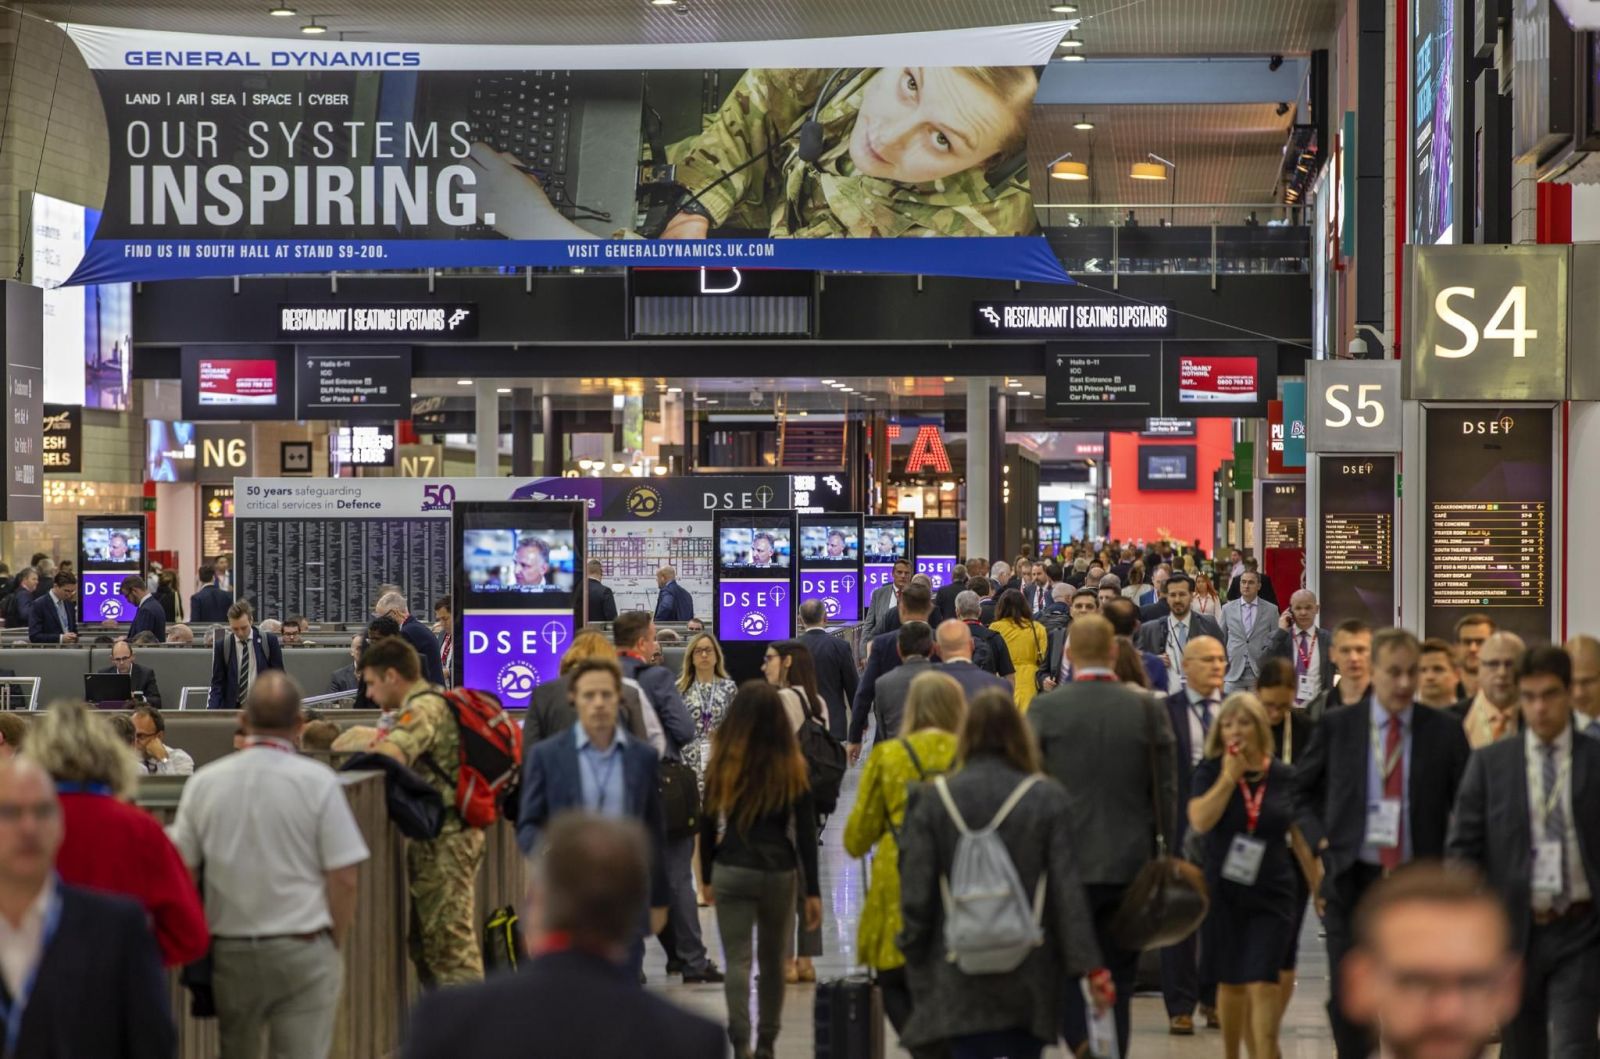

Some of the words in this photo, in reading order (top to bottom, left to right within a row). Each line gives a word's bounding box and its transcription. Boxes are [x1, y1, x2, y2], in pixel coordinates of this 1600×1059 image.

[125, 52, 260, 66] GENERAL
[272, 52, 420, 66] DYNAMICS
[126, 94, 160, 104] LAND
[177, 94, 197, 104] AIR
[211, 94, 236, 104] SEA
[253, 94, 291, 104] SPACE
[309, 94, 348, 105] CYBER
[128, 121, 217, 158] OUR
[249, 121, 470, 158] SYSTEMS
[131, 165, 495, 225] INSPIRING.
[125, 245, 151, 257] FIND
[158, 245, 172, 257] US
[179, 245, 190, 257] IN
[196, 245, 234, 257] SOUTH
[241, 246, 269, 257] HALL
[275, 245, 289, 257] AT
[295, 246, 332, 257] STAND
[339, 246, 387, 257] S9-200.
[568, 245, 599, 257] VISIT
[606, 244, 773, 257] GENERALDYNAMICS.UK.COM
[283, 309, 346, 330] RESTAURANT
[355, 310, 395, 330] SEATING
[397, 310, 444, 330] UPSTAIRS
[1005, 307, 1068, 327] RESTAURANT
[1077, 307, 1117, 327] SEATING
[1119, 306, 1166, 327] UPSTAIRS
[1434, 286, 1537, 358] S4
[1326, 385, 1384, 427] S5
[1462, 418, 1512, 435] DSEI
[204, 439, 246, 466] N6
[402, 457, 434, 477] N7
[1342, 464, 1372, 475] DSEI
[247, 487, 260, 495] 50
[264, 489, 292, 498] years
[295, 486, 362, 498] safeguarding
[423, 484, 456, 507] 50
[703, 488, 773, 509] DSEI
[246, 500, 278, 510] critical
[282, 500, 322, 510] services
[324, 500, 332, 510] in
[337, 500, 381, 508] Defence
[918, 562, 951, 573] DSEI
[84, 580, 121, 597] DSE
[802, 577, 854, 593] DSEI
[723, 589, 783, 607] DSEI
[469, 625, 560, 654] DSEI
